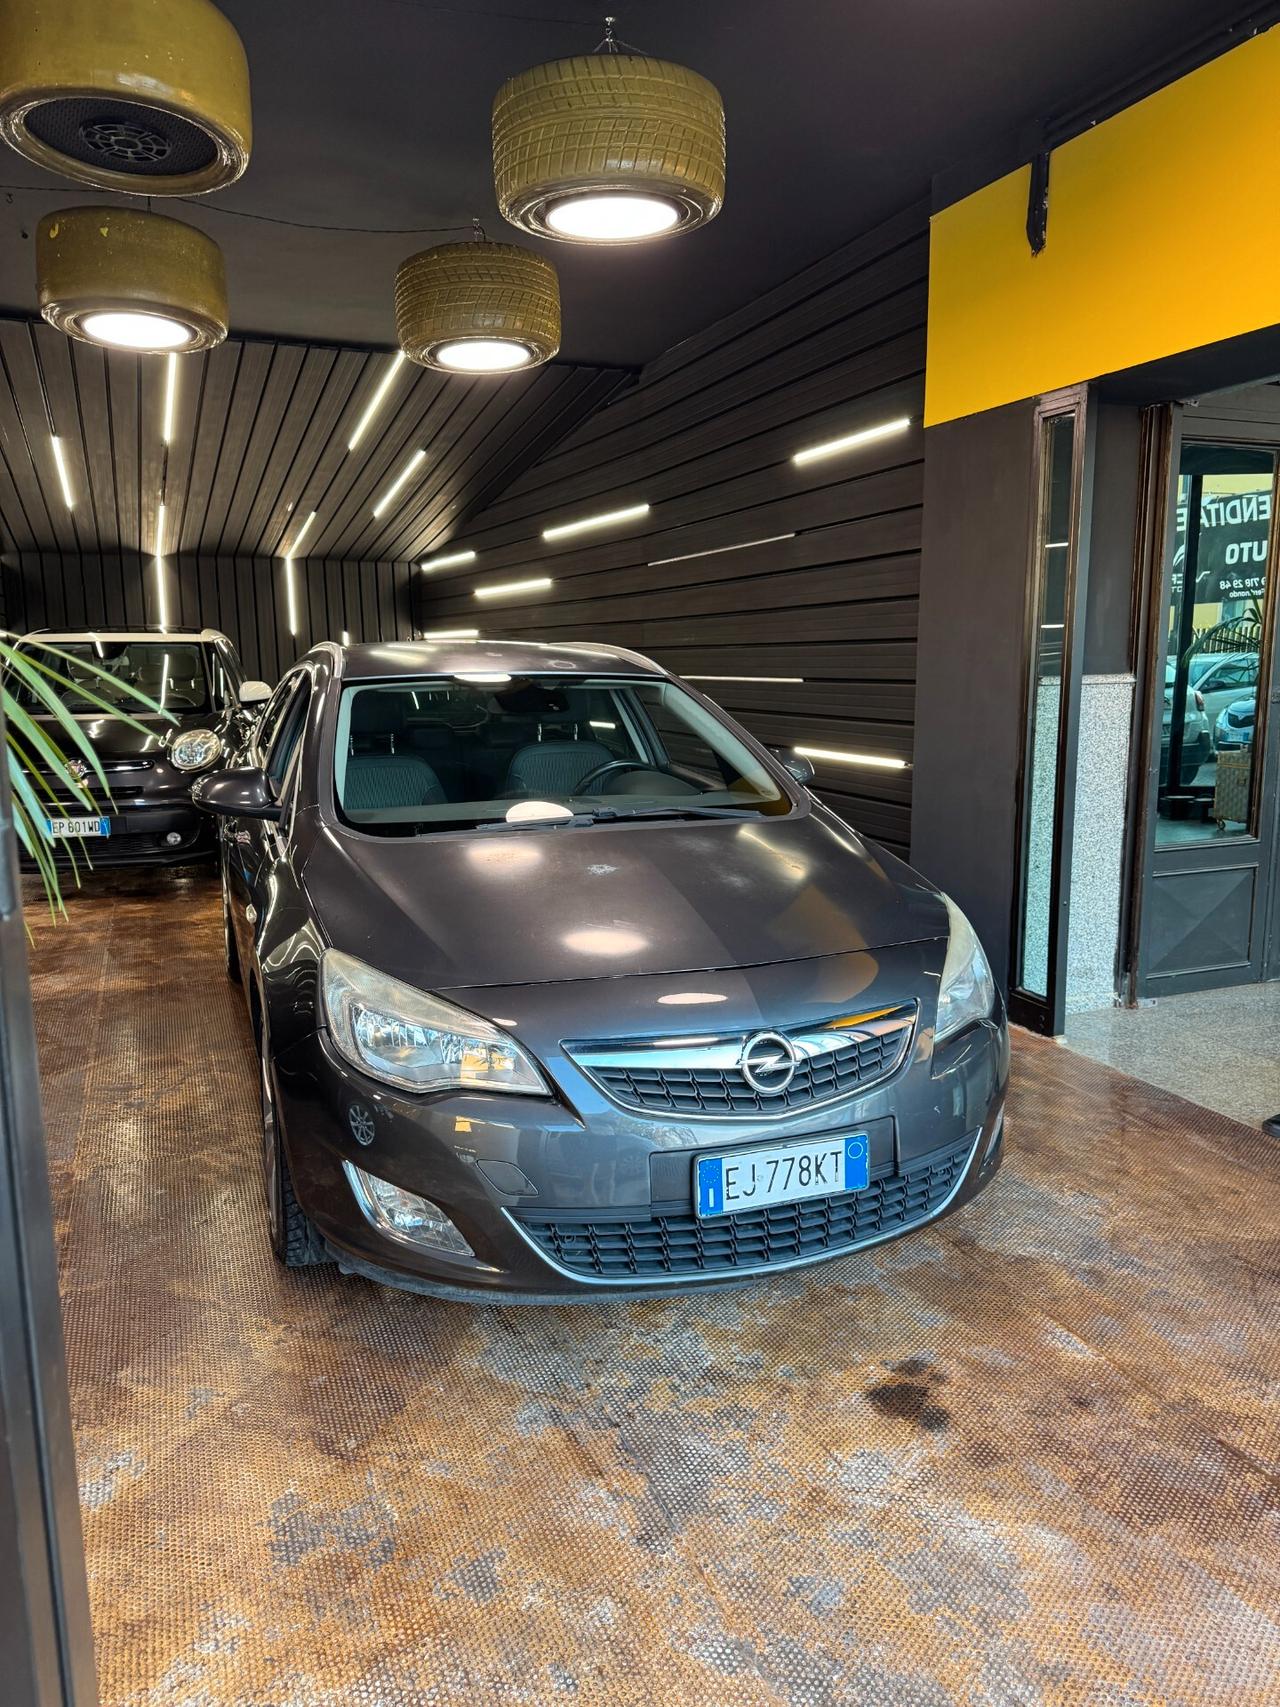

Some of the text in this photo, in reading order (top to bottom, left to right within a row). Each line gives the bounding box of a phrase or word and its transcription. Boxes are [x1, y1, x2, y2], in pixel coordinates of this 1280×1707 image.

[52, 820, 100, 834] EP 601WD
[725, 1151, 842, 1200] EJ 778KT
